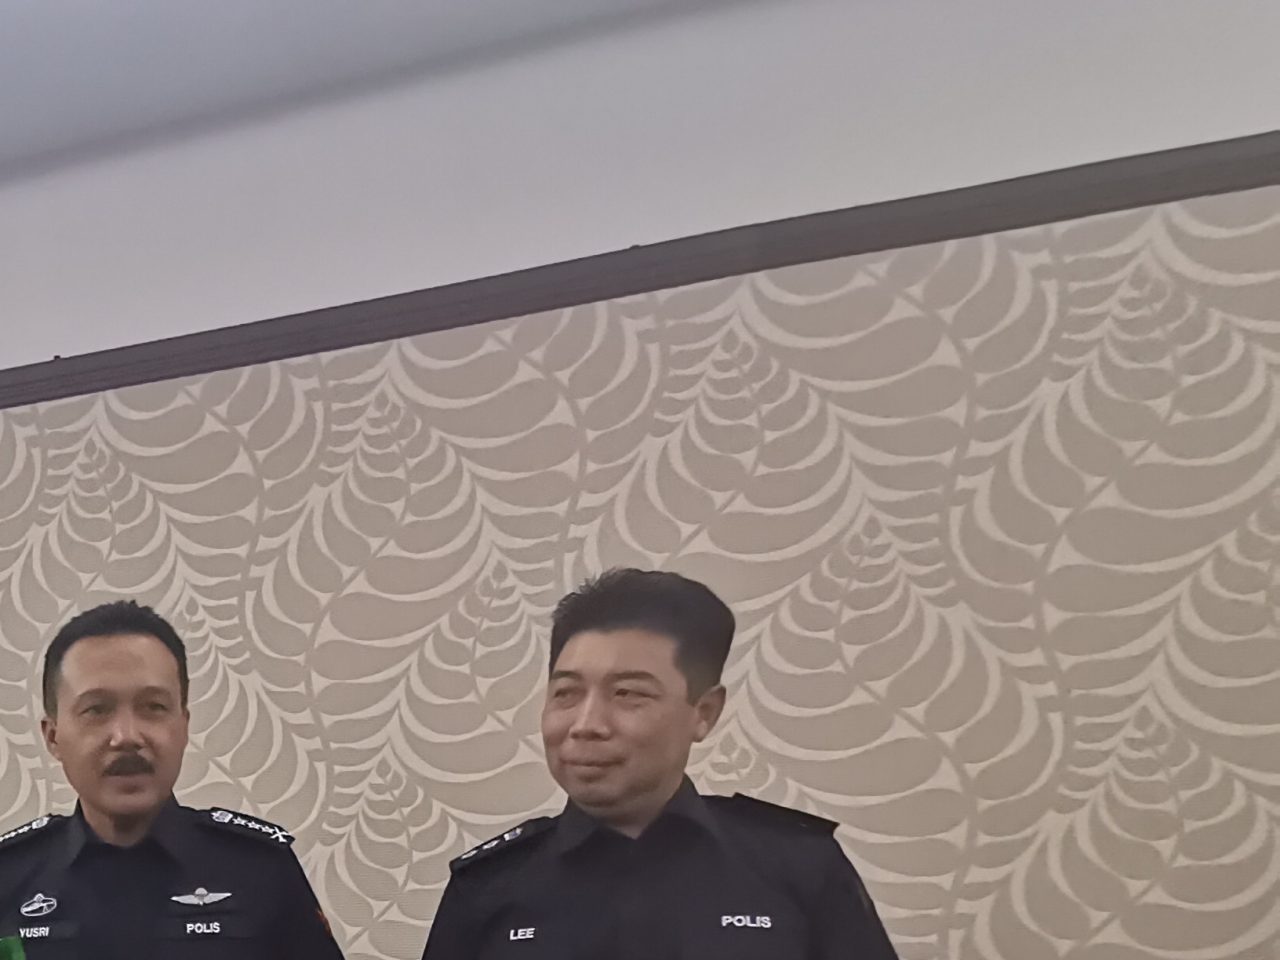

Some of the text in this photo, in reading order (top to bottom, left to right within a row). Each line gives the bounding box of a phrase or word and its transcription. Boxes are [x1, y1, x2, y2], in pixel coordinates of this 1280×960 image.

[186, 921, 221, 934] POLIS
[721, 915, 772, 928] POLIS
[19, 926, 50, 938] YUSRI
[509, 927, 536, 941] LEE
